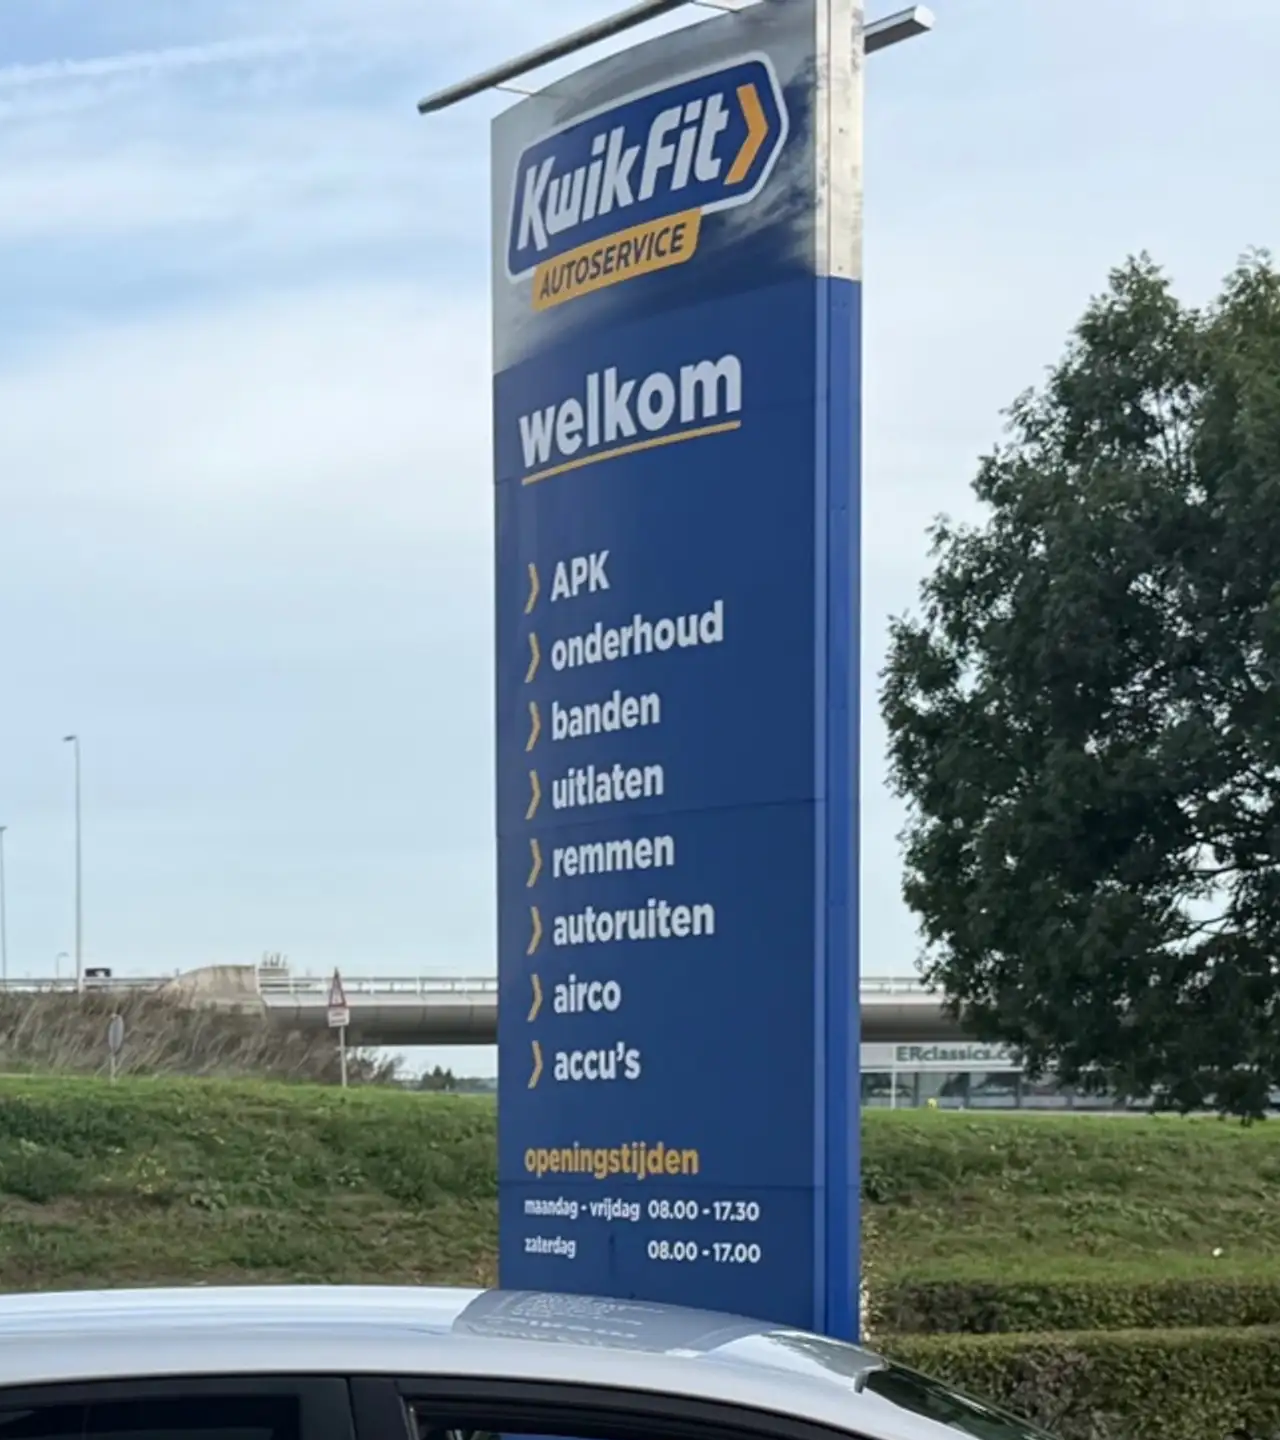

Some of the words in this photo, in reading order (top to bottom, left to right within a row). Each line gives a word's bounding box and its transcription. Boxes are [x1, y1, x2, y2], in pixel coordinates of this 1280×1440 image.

[539, 222, 688, 300] AUTOSERVICE
[519, 354, 742, 468] welkom
[550, 550, 610, 602] APK
[550, 599, 724, 671] onderhoud
[551, 689, 661, 741] banden
[552, 762, 664, 810] uitlaten
[552, 834, 674, 878] remmen
[553, 898, 715, 946] autoruiten
[553, 973, 621, 1014] airco
[554, 1041, 641, 1081] accu's
[524, 1142, 700, 1180] openingstijden
[523, 1196, 579, 1220] maandag
[589, 1197, 641, 1222] vrijdag
[647, 1199, 699, 1220] 08.00
[713, 1201, 761, 1222] 17.30
[523, 1235, 577, 1260] zaterdag
[646, 1240, 698, 1261] 08.00
[712, 1242, 762, 1263] 17.00
